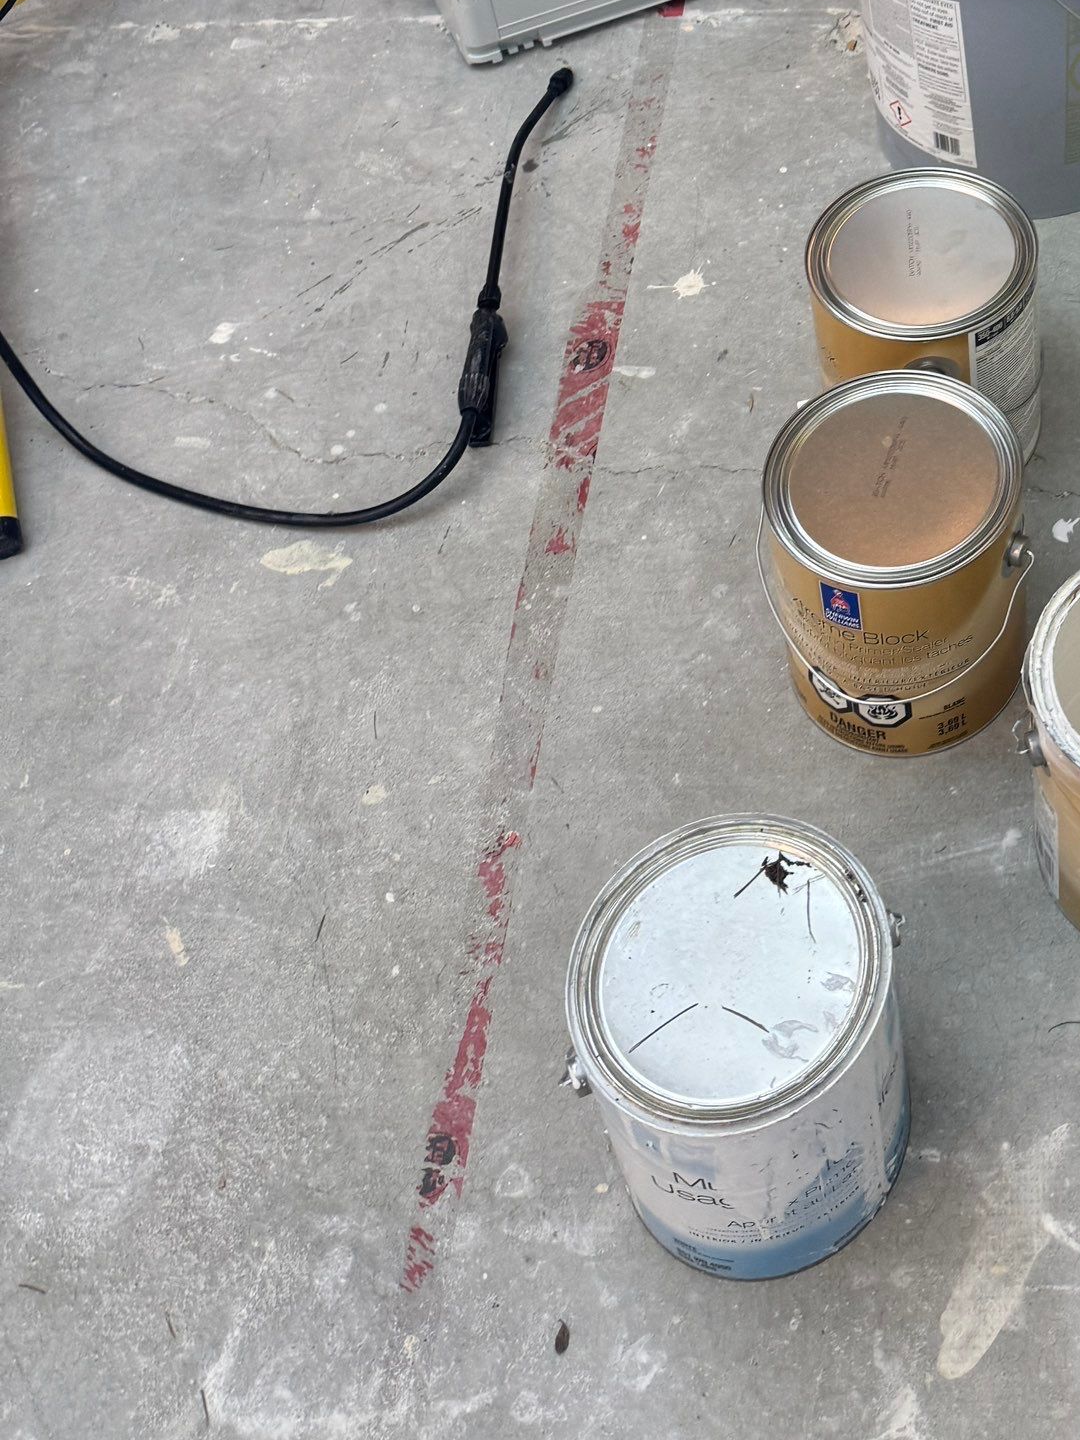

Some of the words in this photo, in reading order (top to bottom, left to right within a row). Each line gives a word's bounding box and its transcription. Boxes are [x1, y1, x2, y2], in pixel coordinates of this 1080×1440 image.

[862, 629, 929, 646] Block
[926, 633, 974, 659] taches
[829, 711, 886, 740] DANGER
